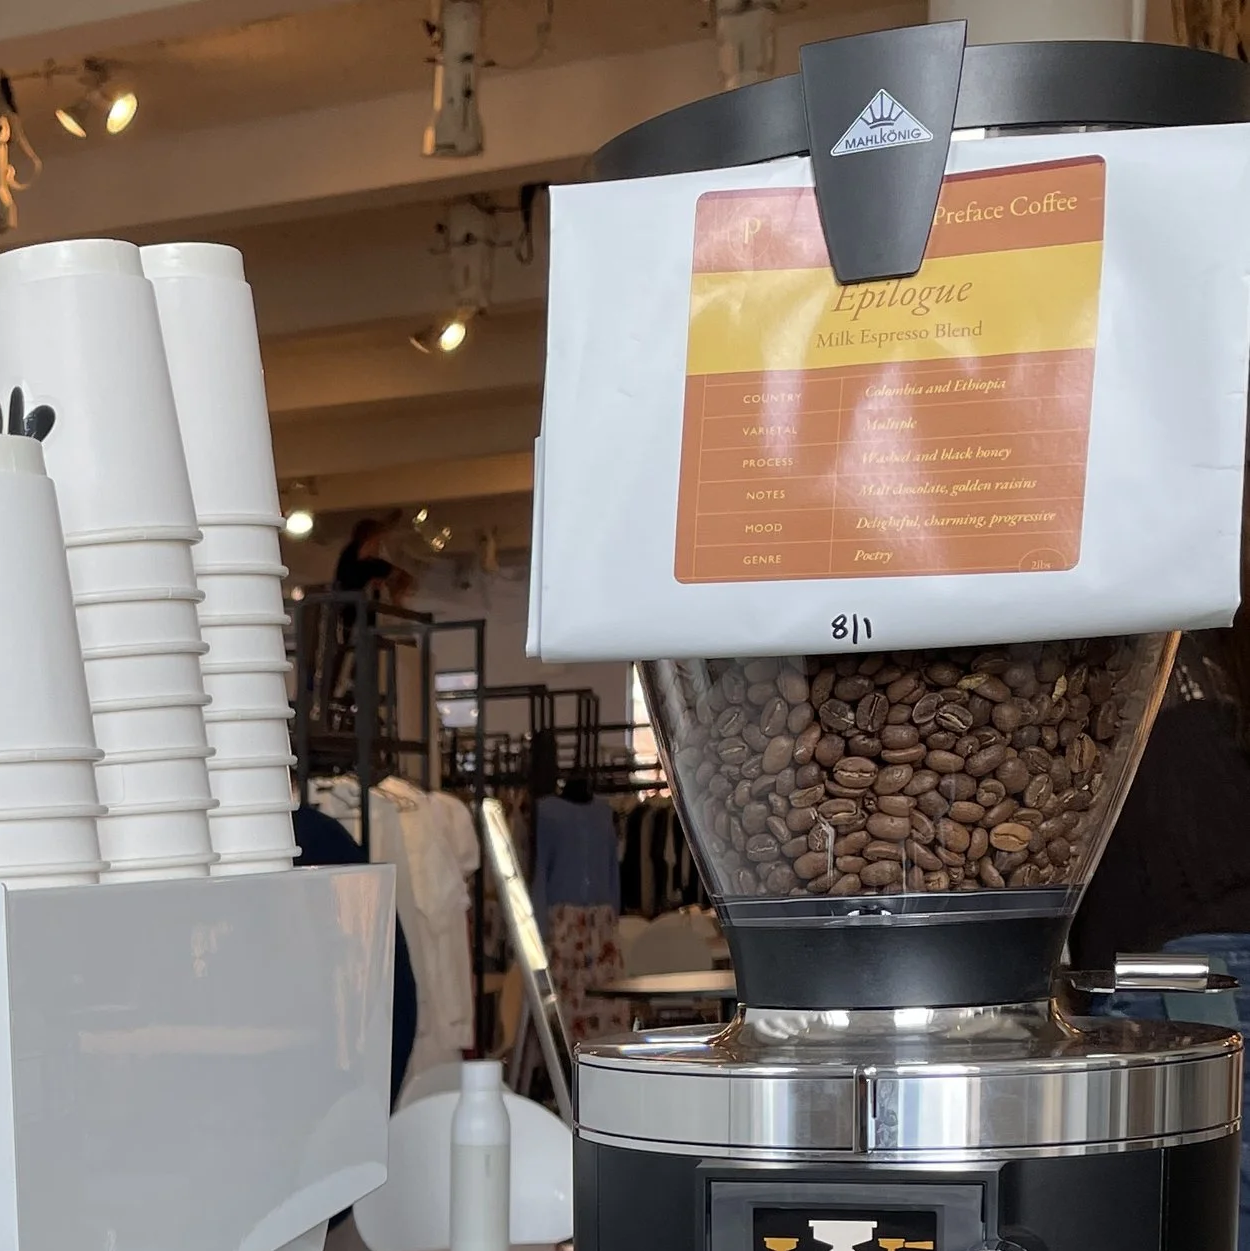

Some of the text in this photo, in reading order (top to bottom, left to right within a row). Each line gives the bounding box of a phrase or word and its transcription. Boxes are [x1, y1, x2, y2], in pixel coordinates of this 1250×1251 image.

[933, 191, 1078, 226] Preface Coffee
[830, 280, 973, 321] Epilogue
[816, 320, 983, 349] Milk Espresso Blend
[865, 378, 1007, 398] Colombia and Ethiopia
[743, 392, 802, 404] COUNTRY
[742, 426, 798, 436] VARIETAL
[742, 457, 794, 468] PROCESS
[912, 448, 937, 463] and
[940, 446, 973, 461] black
[976, 446, 1012, 461] honey
[746, 490, 785, 500] NOTES
[950, 480, 991, 496] golden
[994, 478, 1038, 490] raisins
[924, 512, 988, 528] charming,
[989, 511, 1056, 528] progressive
[745, 523, 783, 533] MOOD
[743, 554, 782, 565] GENRE
[854, 550, 893, 565] Poetry
